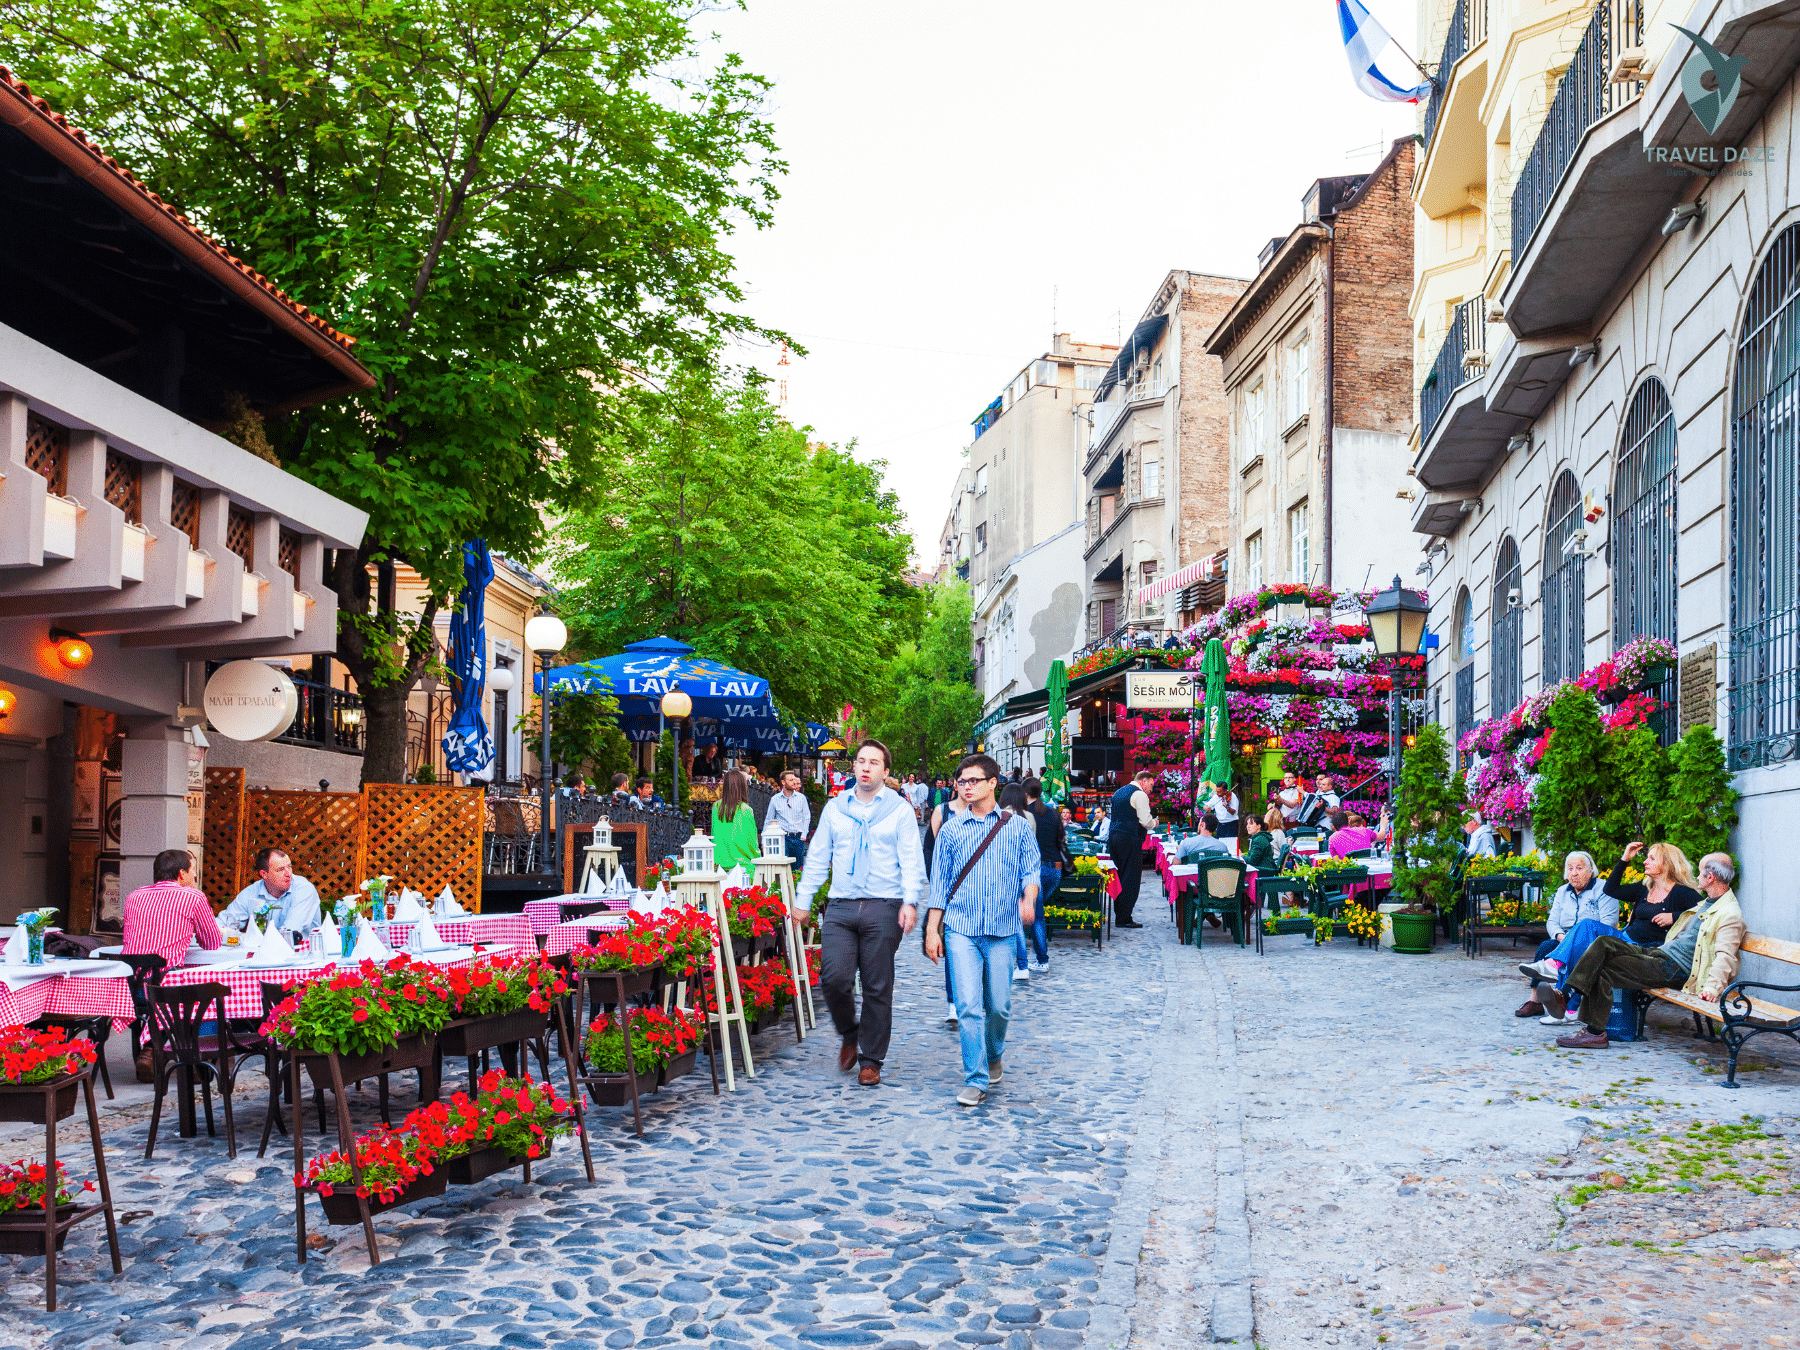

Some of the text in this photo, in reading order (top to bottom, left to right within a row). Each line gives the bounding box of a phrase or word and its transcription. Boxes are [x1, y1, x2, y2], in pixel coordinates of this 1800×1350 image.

[629, 678, 680, 693] LAV
[709, 681, 760, 696] LAV
[1133, 684, 1192, 696] ŠEŠIR MOJ
